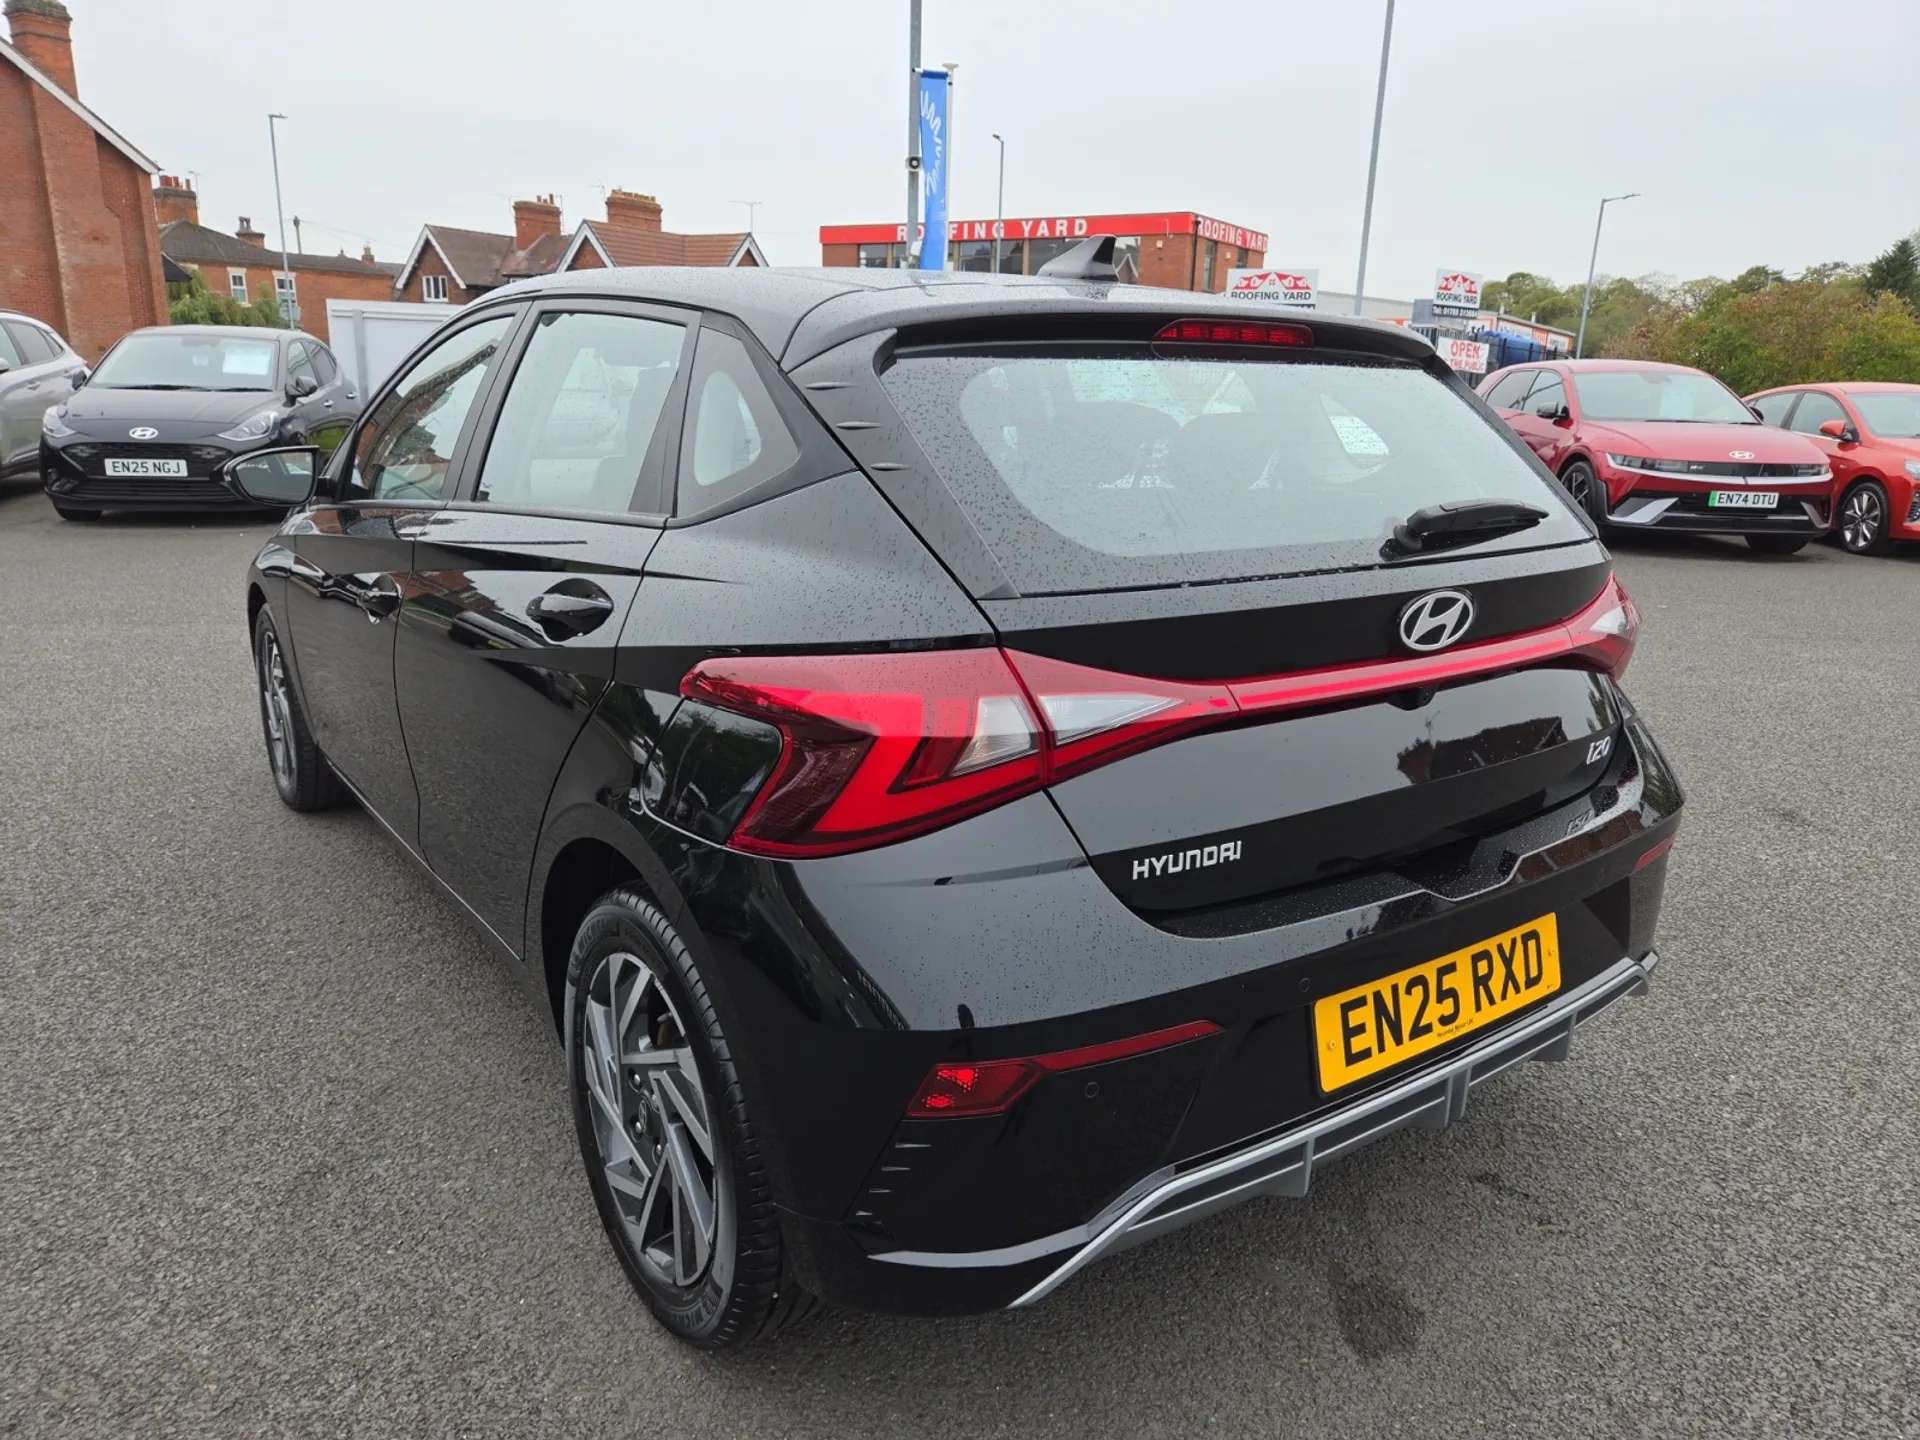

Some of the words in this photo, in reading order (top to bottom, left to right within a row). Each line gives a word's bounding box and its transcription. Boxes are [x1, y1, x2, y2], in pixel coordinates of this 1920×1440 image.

[896, 221, 1005, 241] ROFING
[1021, 218, 1088, 237] YARD
[1197, 216, 1241, 244] ROOFING
[1246, 231, 1268, 251] YARD
[1231, 291, 1279, 300] ROOFING
[1282, 291, 1311, 300] YARD
[1436, 291, 1461, 303] ROOFING
[1463, 295, 1477, 304] YARD
[1450, 340, 1480, 358] OPEN
[111, 460, 149, 473] EN25
[152, 460, 181, 473] NGJ
[1717, 493, 1749, 505] EN74
[1752, 493, 1776, 506] DTU
[1132, 839, 1242, 880] HYUNDAI
[1340, 962, 1460, 1067] EN25
[1471, 928, 1543, 1014] RXD
